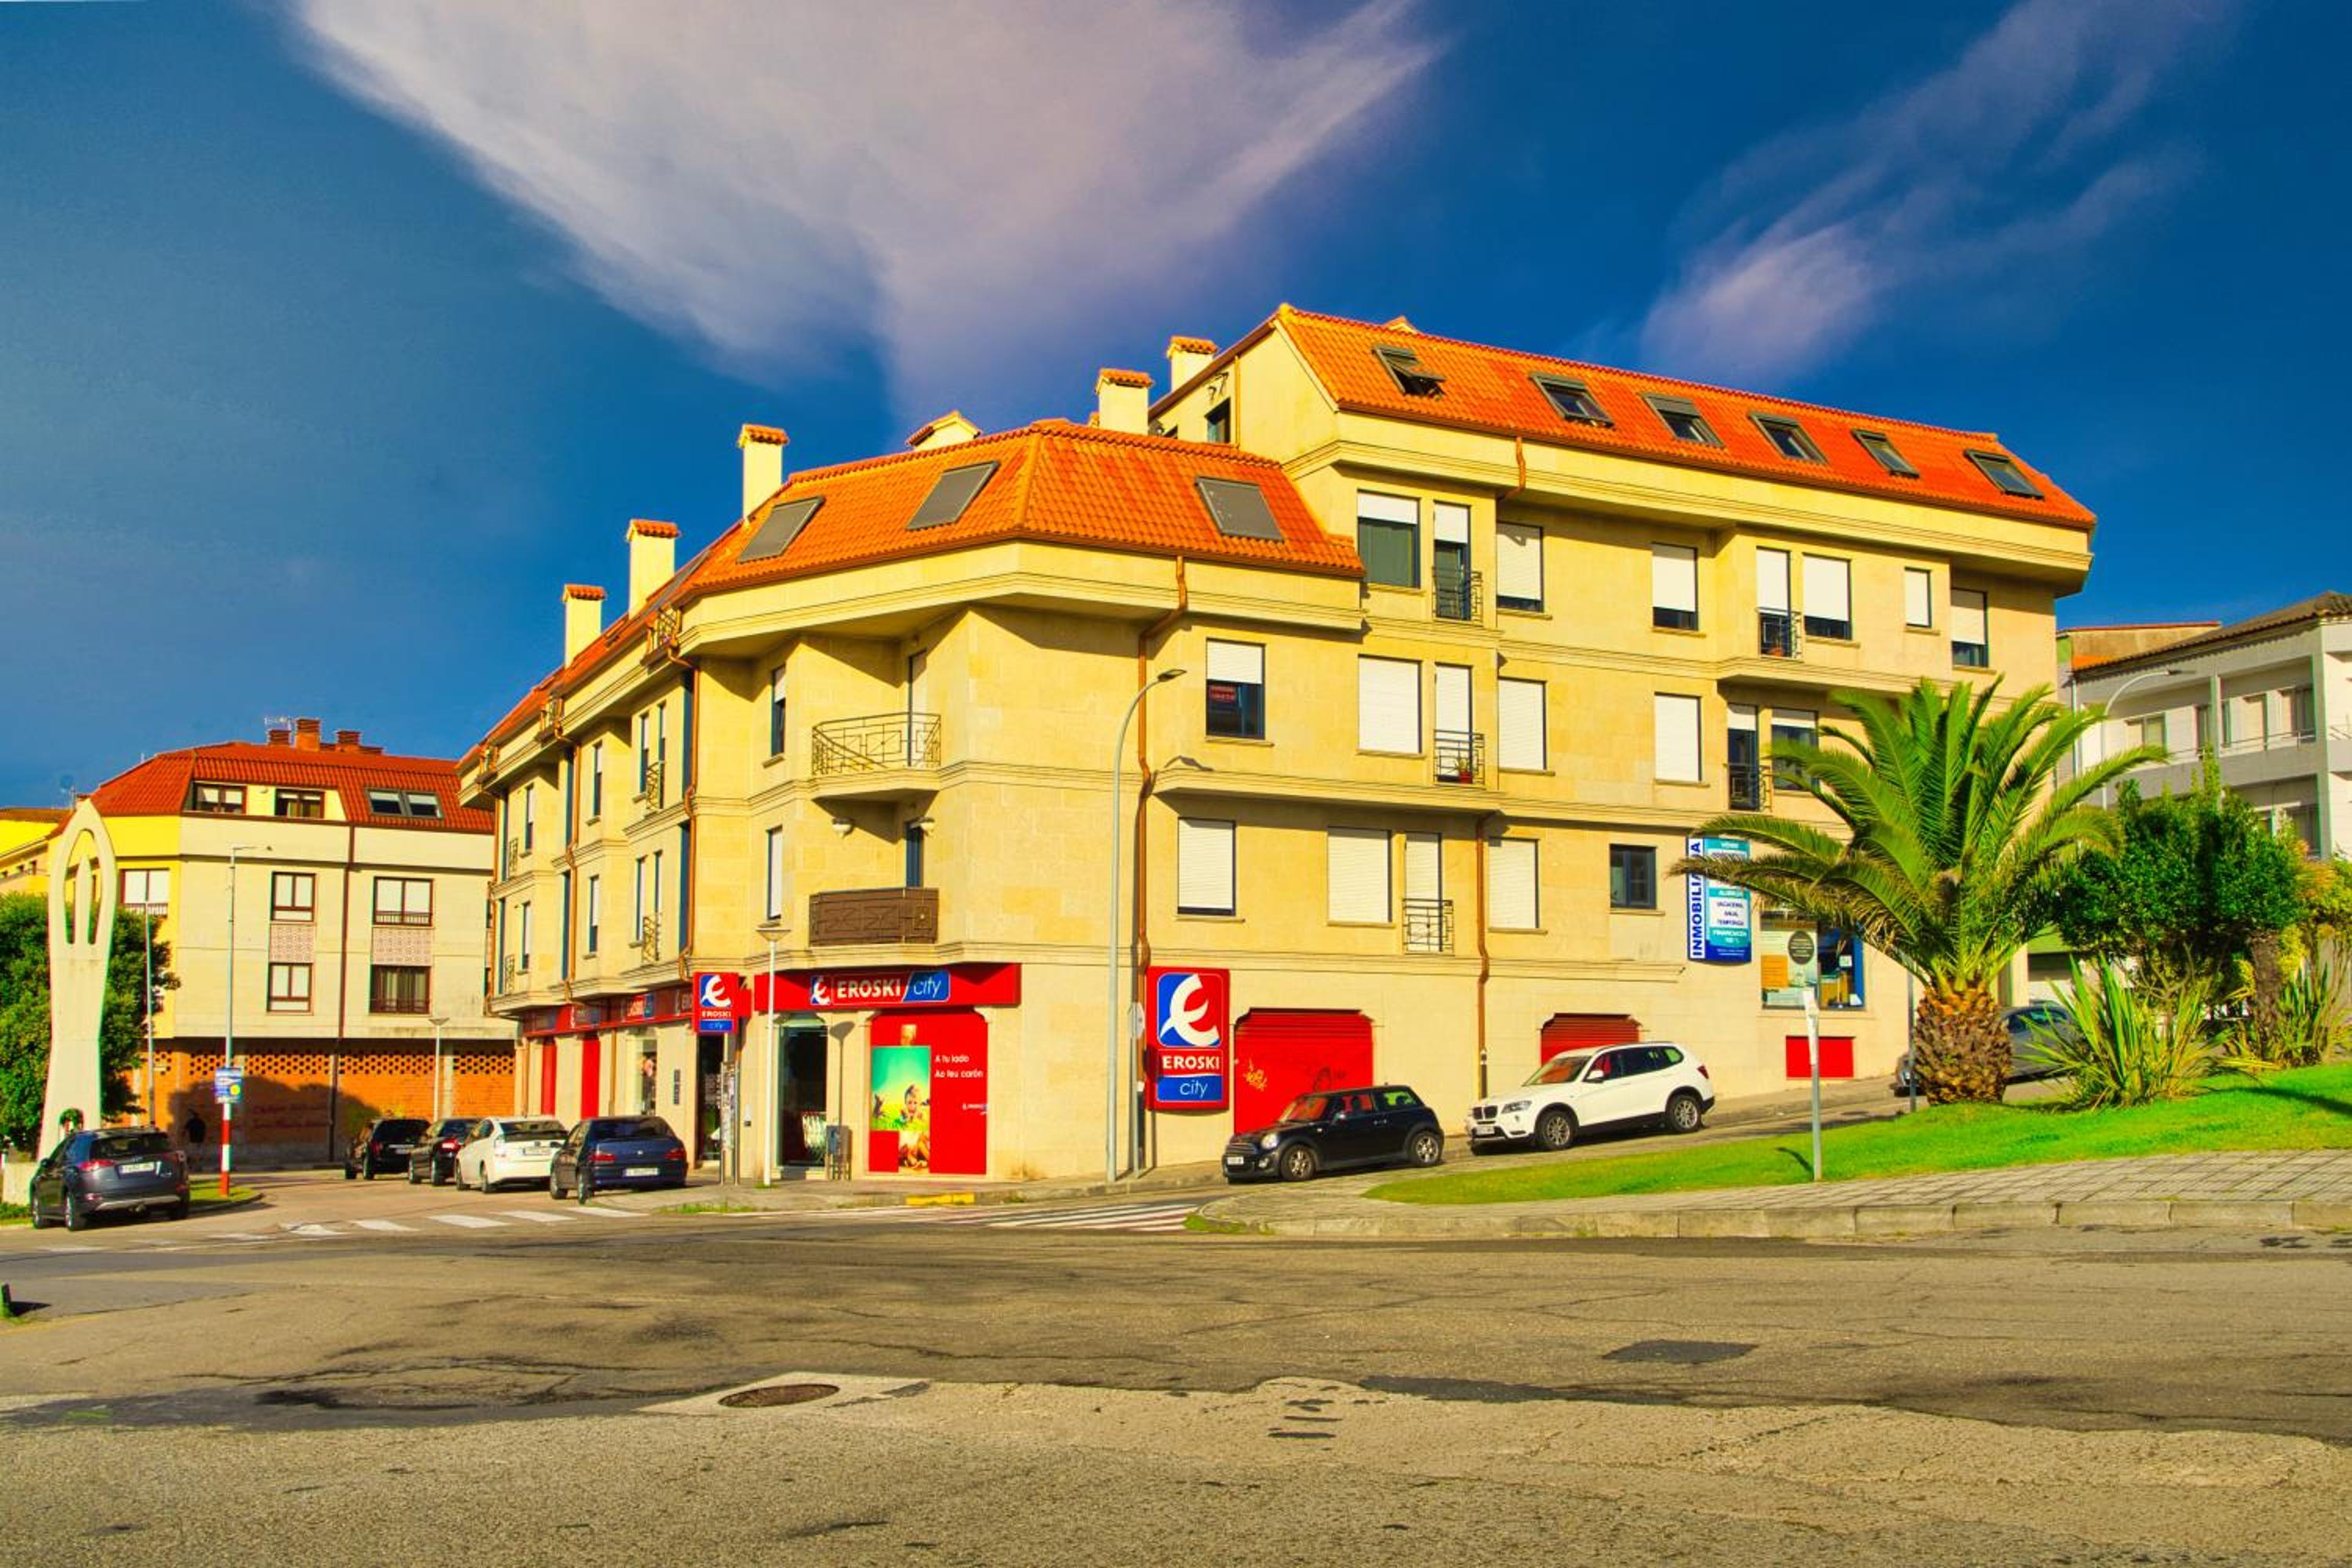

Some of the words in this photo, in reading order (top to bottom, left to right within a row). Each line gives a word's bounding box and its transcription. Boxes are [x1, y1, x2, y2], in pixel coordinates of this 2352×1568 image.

[1690, 842, 1702, 956] INMOBILIA
[837, 978, 901, 999] EROSKI
[913, 976, 942, 998] city
[1162, 1055, 1220, 1069] EROSKI
[1180, 1080, 1208, 1098] city
